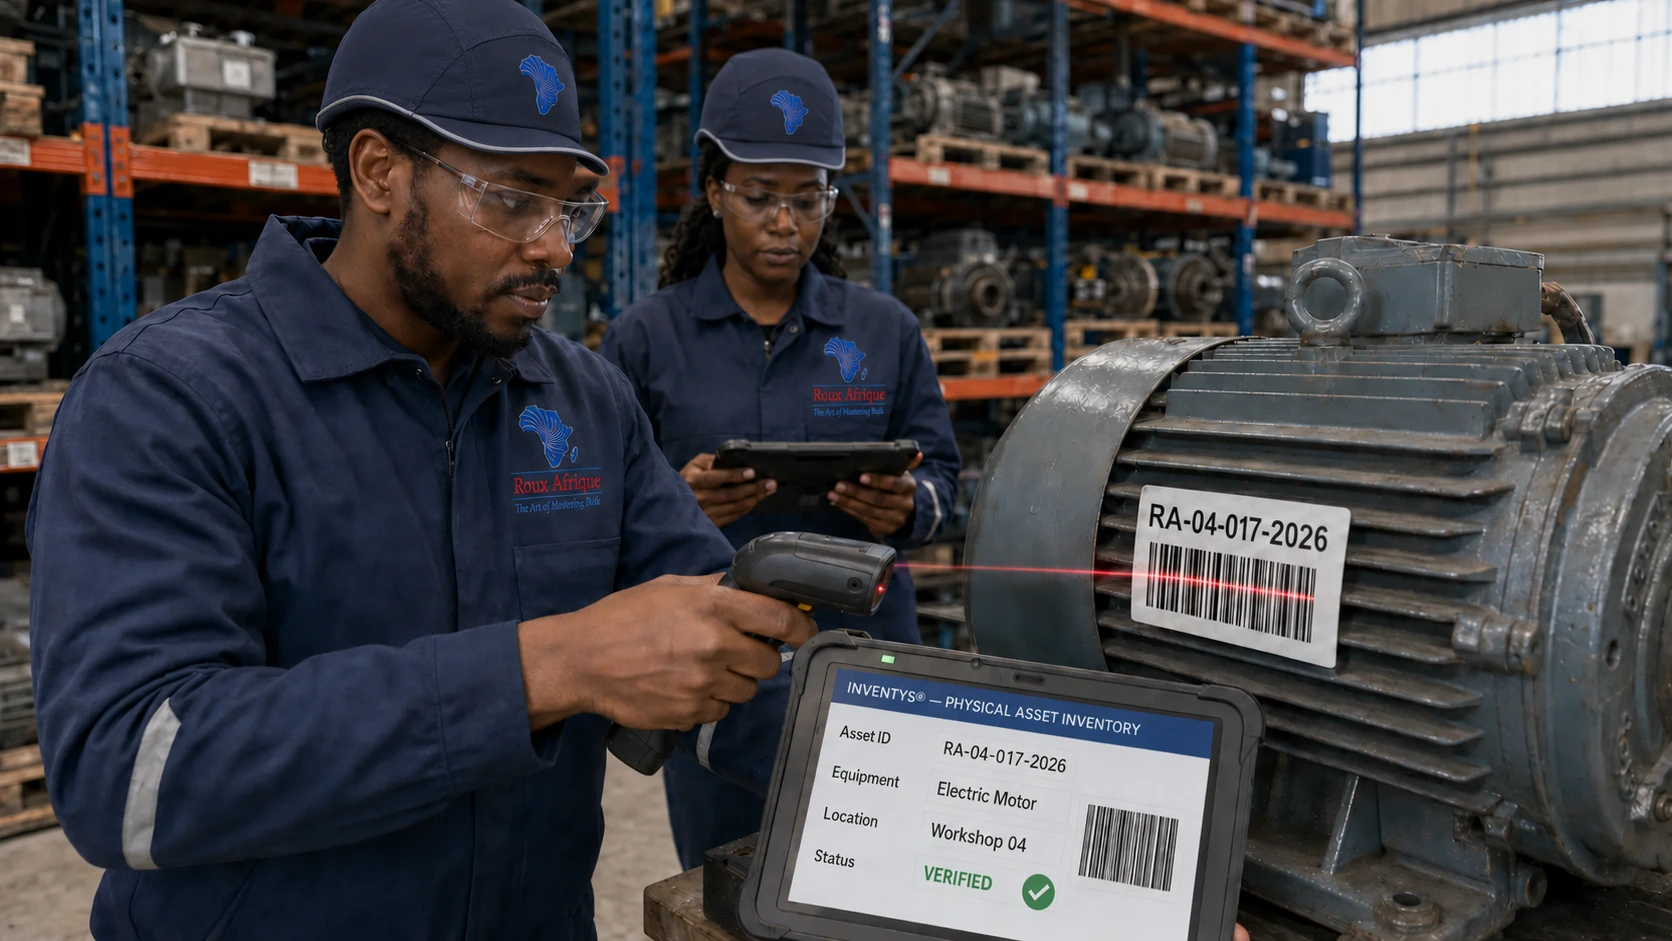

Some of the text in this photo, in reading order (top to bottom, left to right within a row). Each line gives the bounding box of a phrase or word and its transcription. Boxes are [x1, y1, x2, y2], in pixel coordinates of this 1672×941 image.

[813, 387, 886, 405] Roux Afrique
[813, 408, 824, 416] The
[825, 408, 834, 416] Art
[836, 408, 843, 418] of
[513, 473, 601, 494] Roux Afrique
[515, 504, 529, 513] The
[530, 503, 541, 512] Art
[542, 501, 550, 514] of
[1149, 503, 1328, 552] RA-04-017-2026
[945, 696, 1011, 717] PHYSICAL
[1015, 706, 1059, 723] ASSET
[1061, 713, 1141, 736] INVENTORY
[839, 725, 891, 744] Asset ID
[943, 741, 1066, 774] RA-04-017-2026
[832, 765, 900, 788] Equipment
[937, 781, 1037, 810] Electric Motor
[823, 806, 878, 828] Location
[931, 822, 1027, 853] Workshop 04
[814, 849, 855, 868] Status
[924, 865, 993, 891] VERIFIED
